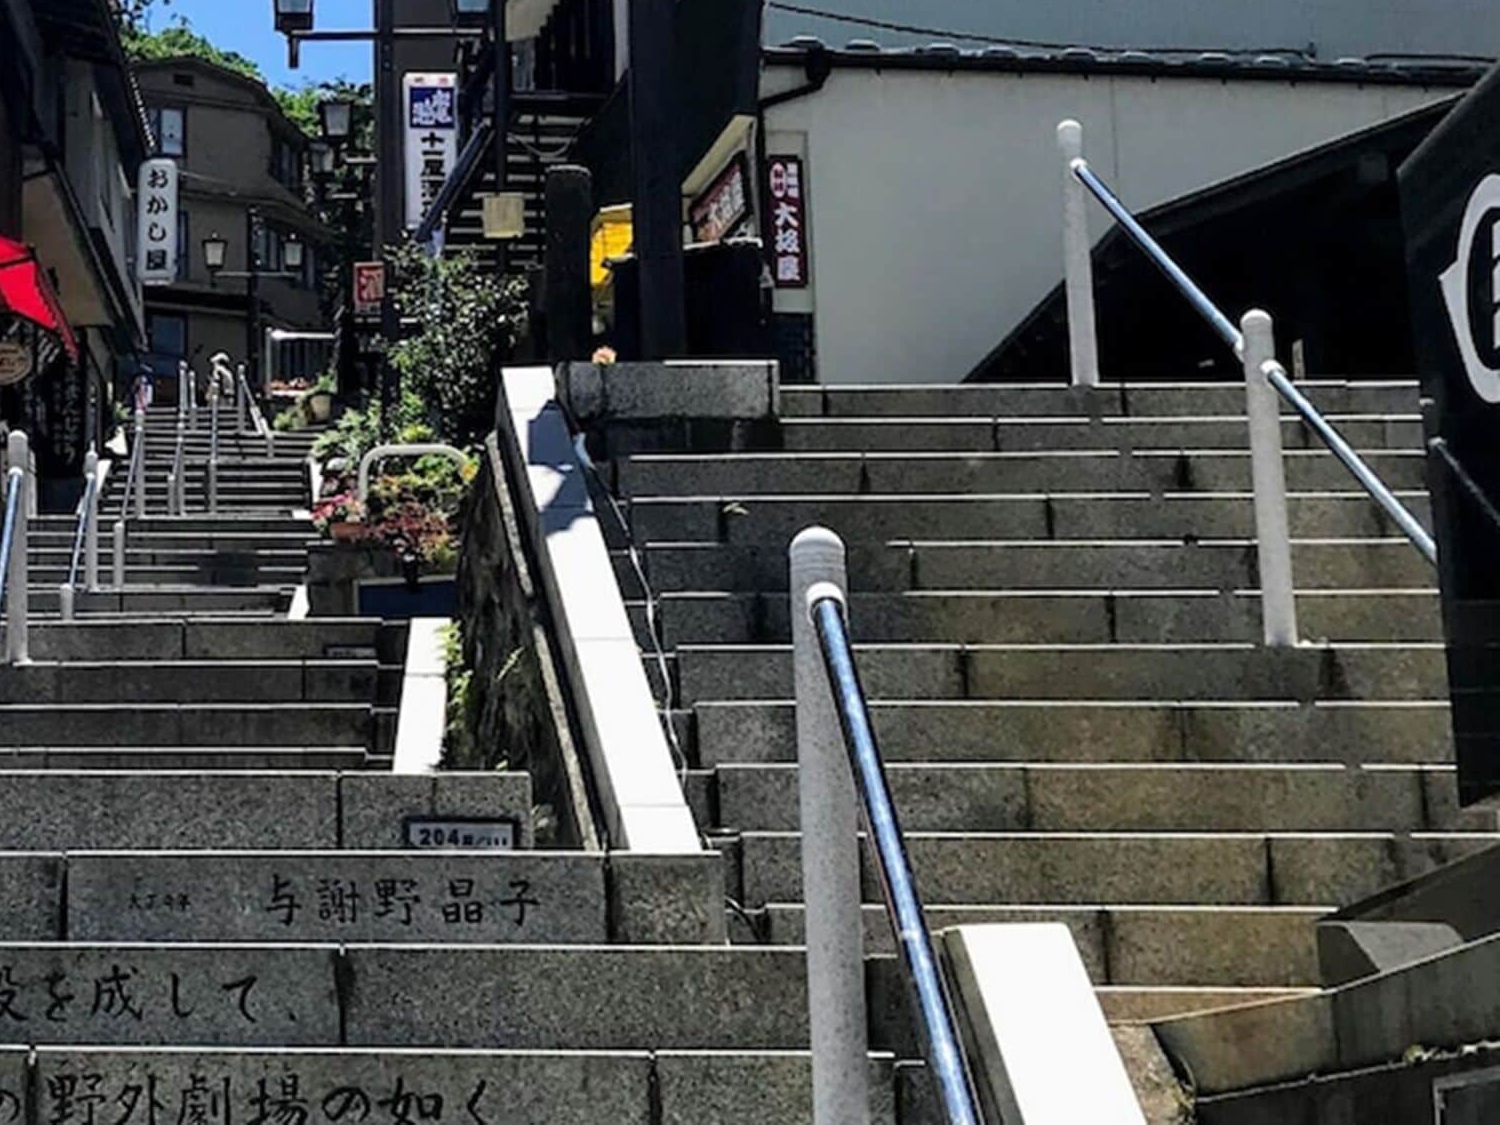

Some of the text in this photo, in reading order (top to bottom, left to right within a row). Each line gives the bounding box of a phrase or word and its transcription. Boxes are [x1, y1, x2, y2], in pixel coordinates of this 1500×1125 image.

[146, 168, 169, 271] おかし屋
[265, 877, 541, 926] 与謝野晶子
